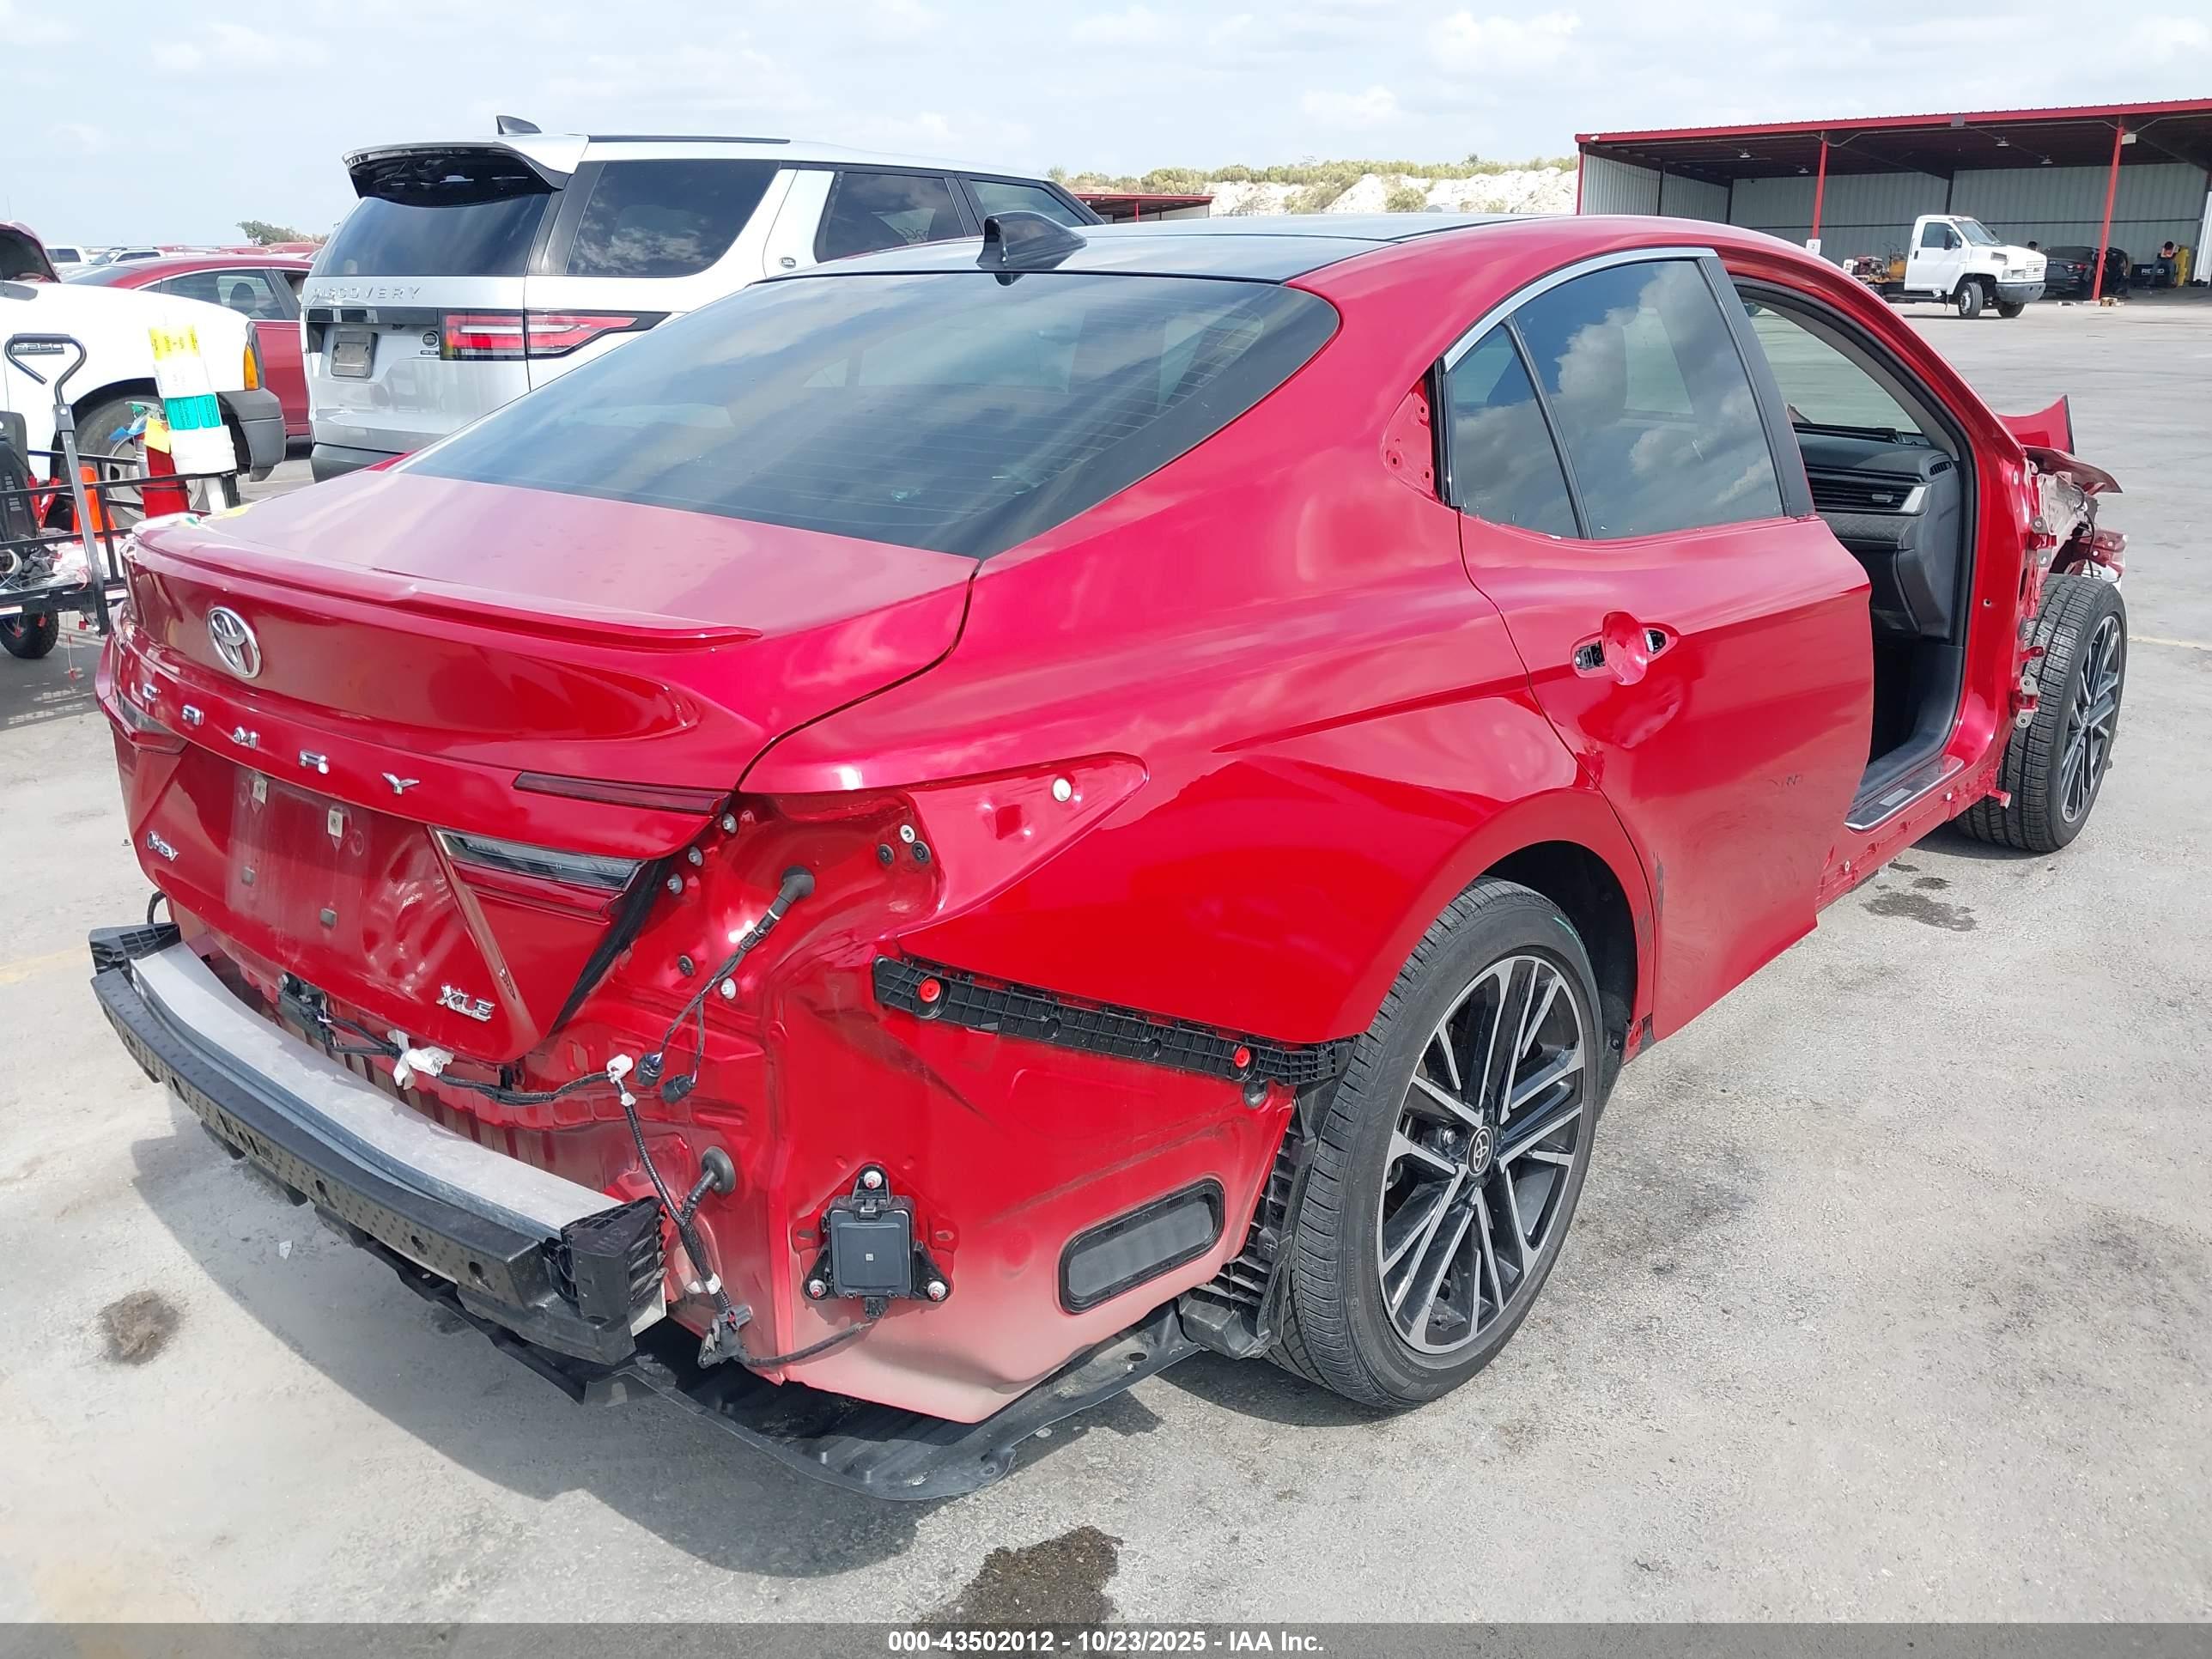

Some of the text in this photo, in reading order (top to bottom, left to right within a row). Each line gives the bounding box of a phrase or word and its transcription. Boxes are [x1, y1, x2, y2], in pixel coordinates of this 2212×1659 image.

[313, 287, 421, 300] DISCOVERY
[142, 683, 420, 795] CAMRY
[435, 984, 495, 1022] XLE
